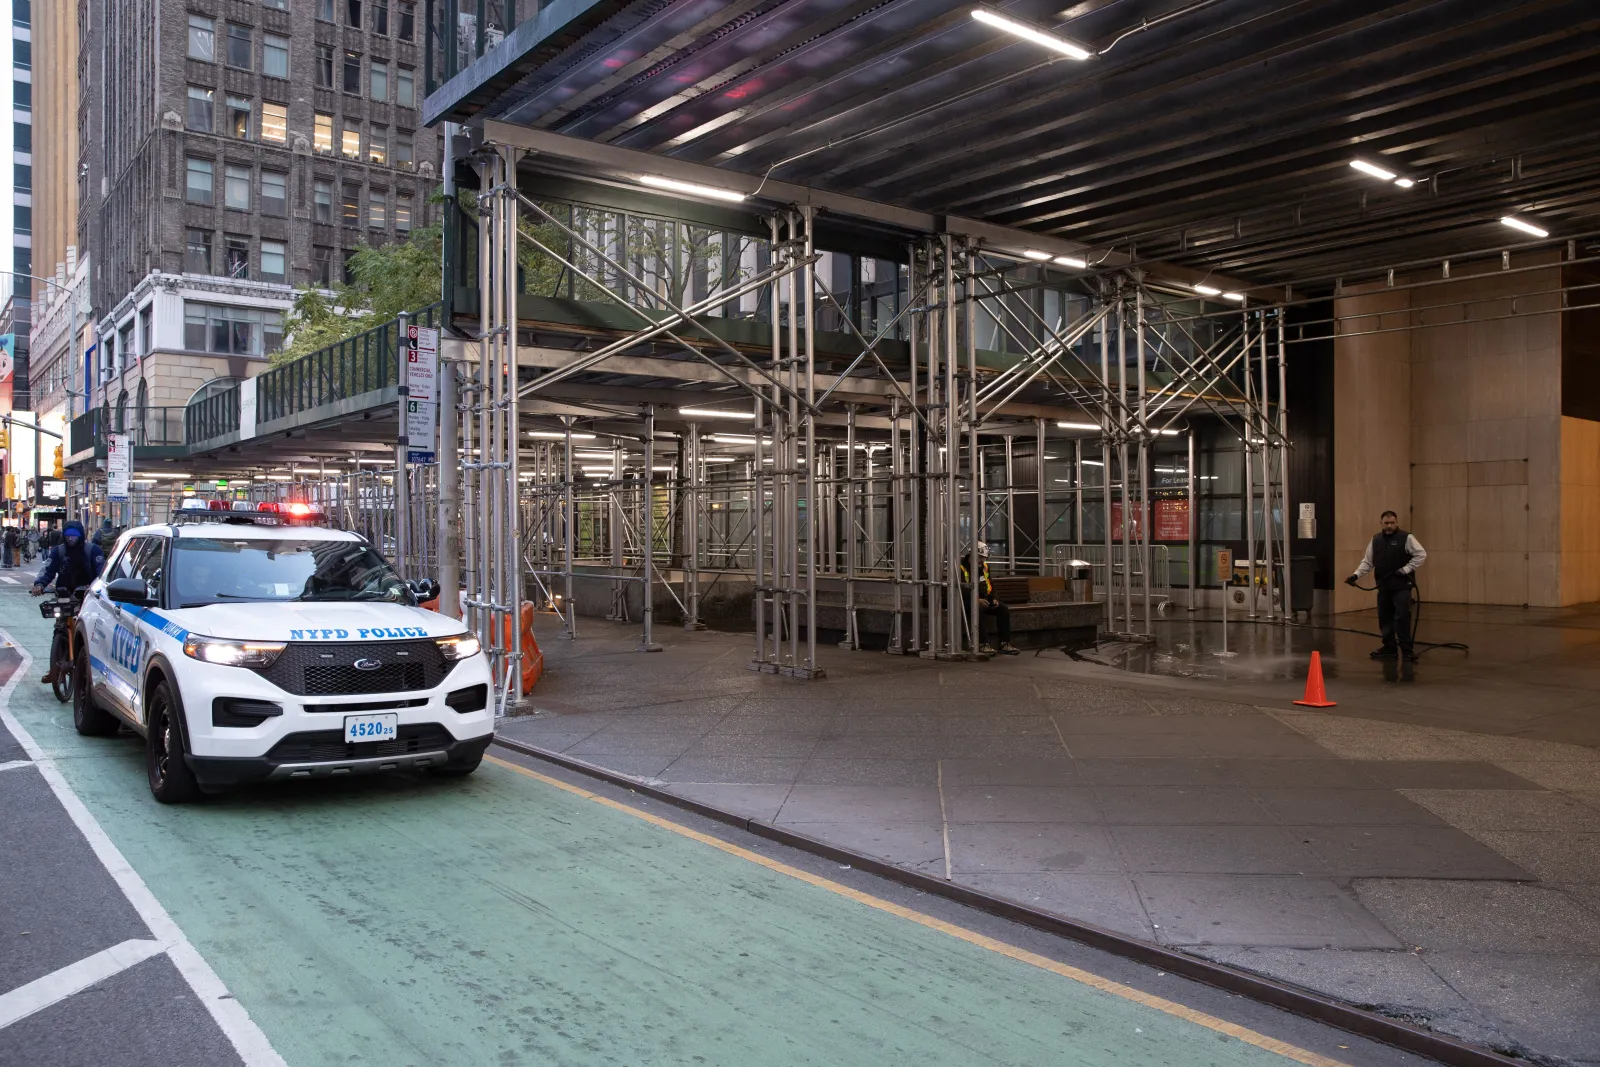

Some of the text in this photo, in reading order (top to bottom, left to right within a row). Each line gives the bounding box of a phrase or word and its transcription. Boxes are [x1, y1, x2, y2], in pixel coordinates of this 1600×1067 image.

[410, 351, 416, 362] 3
[410, 401, 416, 412] 6
[290, 627, 429, 640] NYPD POLICE
[111, 623, 143, 675] NYPD
[350, 722, 383, 736] 4520
